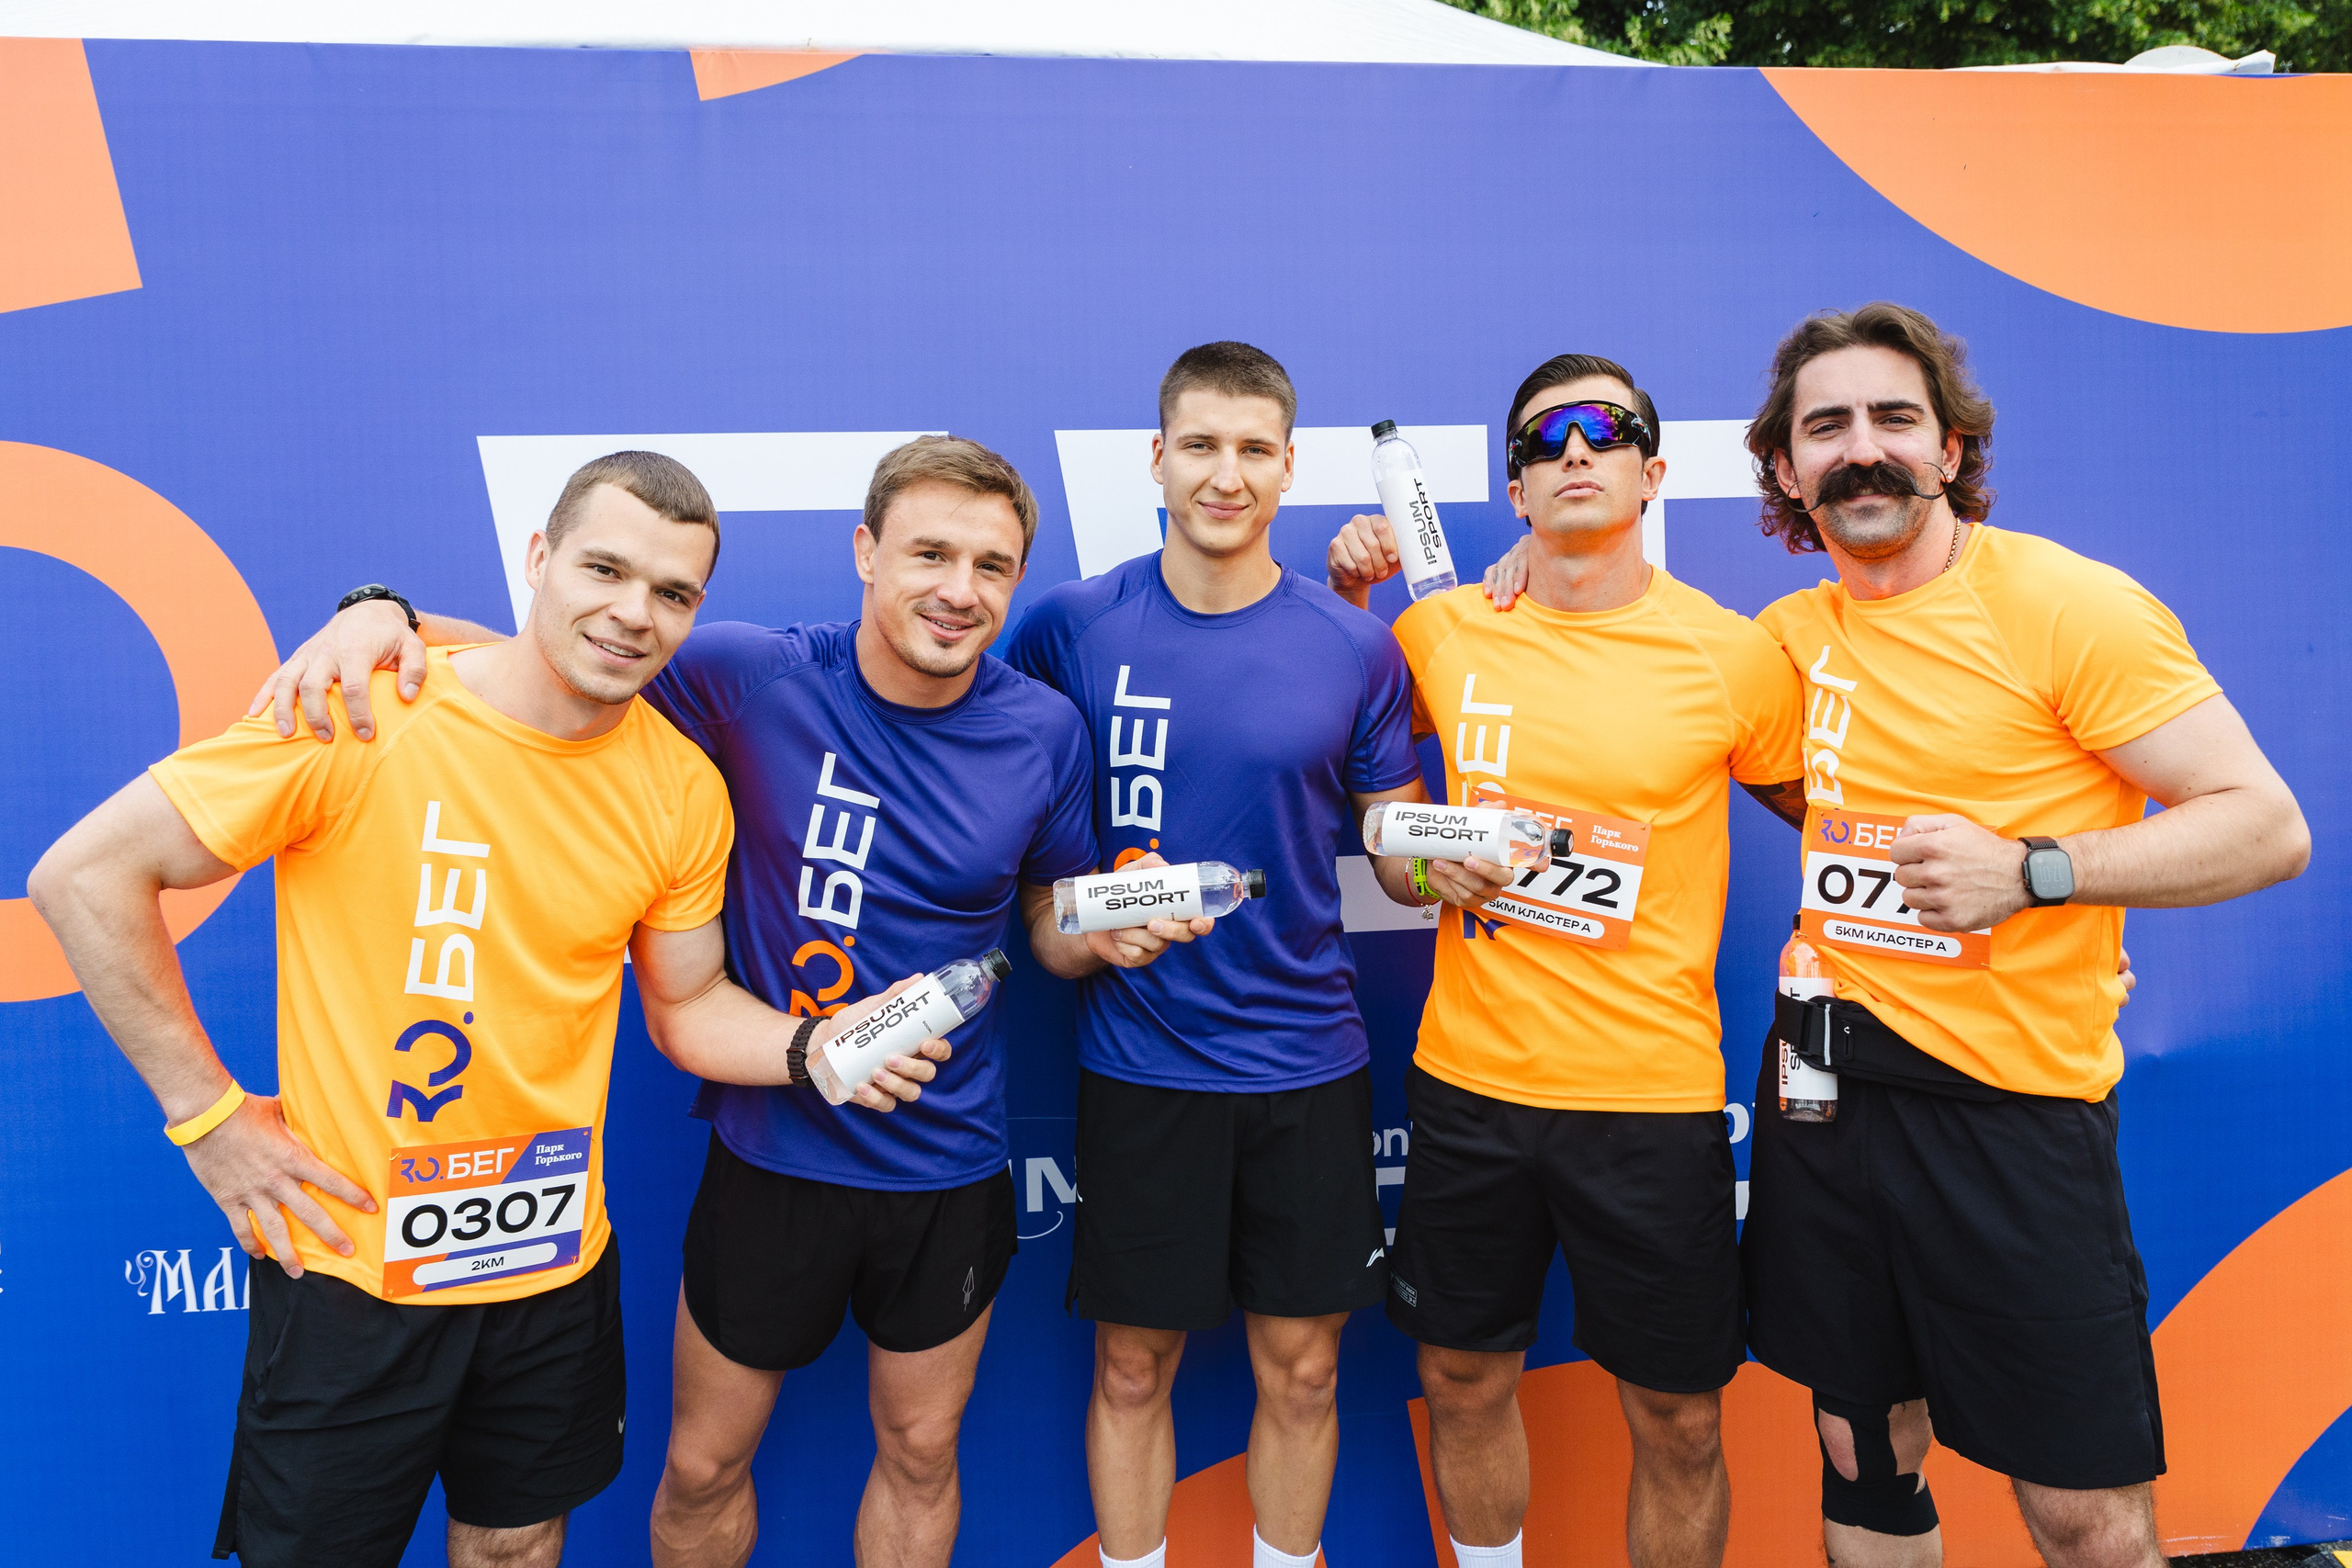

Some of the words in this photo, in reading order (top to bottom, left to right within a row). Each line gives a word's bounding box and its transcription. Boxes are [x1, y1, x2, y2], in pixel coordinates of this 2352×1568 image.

[1414, 479, 1442, 548] SPORT
[1409, 501, 1437, 565] IPSUM
[1395, 810, 1467, 827] IPSUM
[1408, 824, 1489, 842] SPORT
[1592, 824, 1622, 840] Парк
[1590, 834, 1639, 852] Горького
[1088, 879, 1164, 898] IPSUM
[1105, 889, 1190, 911] SPORT
[1518, 907, 1580, 929] КЛАСТЕР
[1835, 925, 1864, 940] 5КМ
[1867, 931, 1934, 950] КЛАСТЕР
[834, 996, 905, 1048] IPSUM
[854, 990, 931, 1049] SPORT
[535, 1152, 582, 1167] Горького
[536, 1144, 565, 1156] Парк
[401, 1183, 576, 1248] 0307
[471, 1256, 505, 1271] 2КМ
